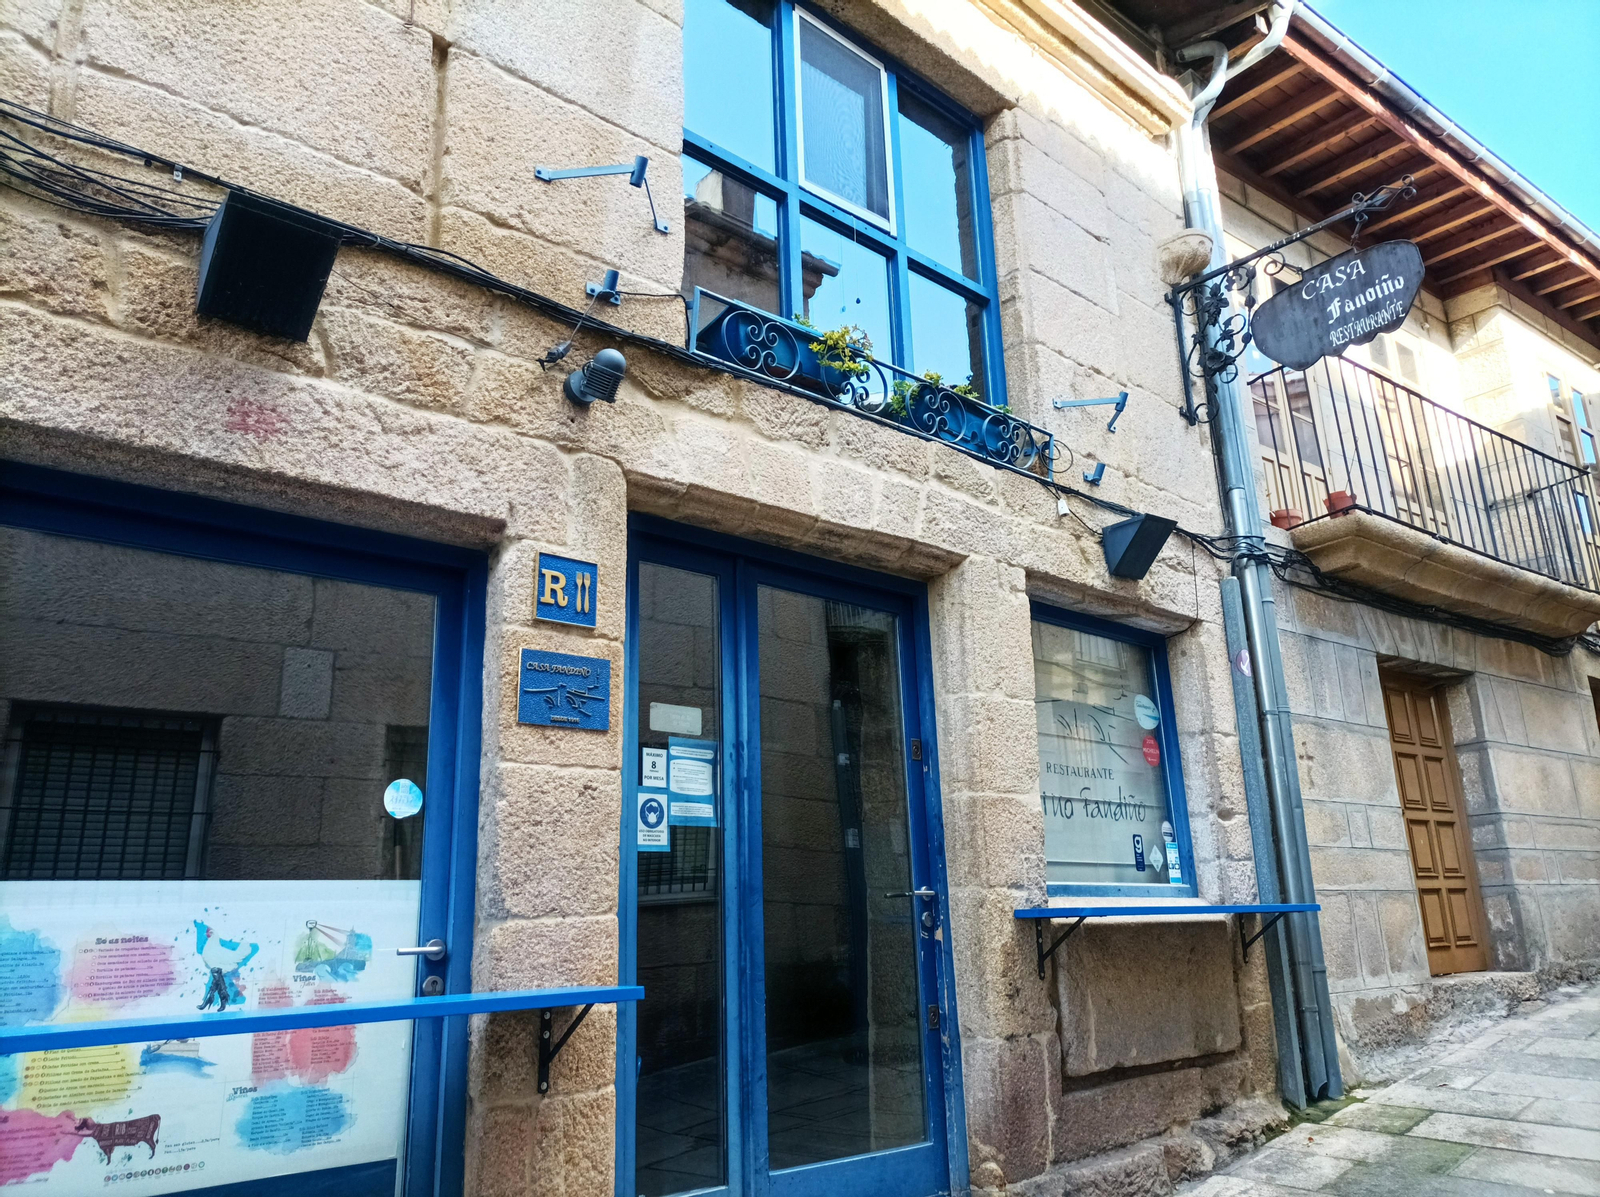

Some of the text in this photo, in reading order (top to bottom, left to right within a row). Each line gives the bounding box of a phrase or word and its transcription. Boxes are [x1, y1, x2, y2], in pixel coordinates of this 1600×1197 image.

[1302, 259, 1366, 300] CASA
[1330, 299, 1405, 346] RESTAURANTE
[540, 568, 568, 607] R
[527, 661, 591, 677] CASA FANDIÑO
[652, 761, 656, 769] 8
[1046, 762, 1114, 780] RESTAURANTE
[1043, 786, 1146, 822] ino Fandiño
[121, 935, 148, 943] noites
